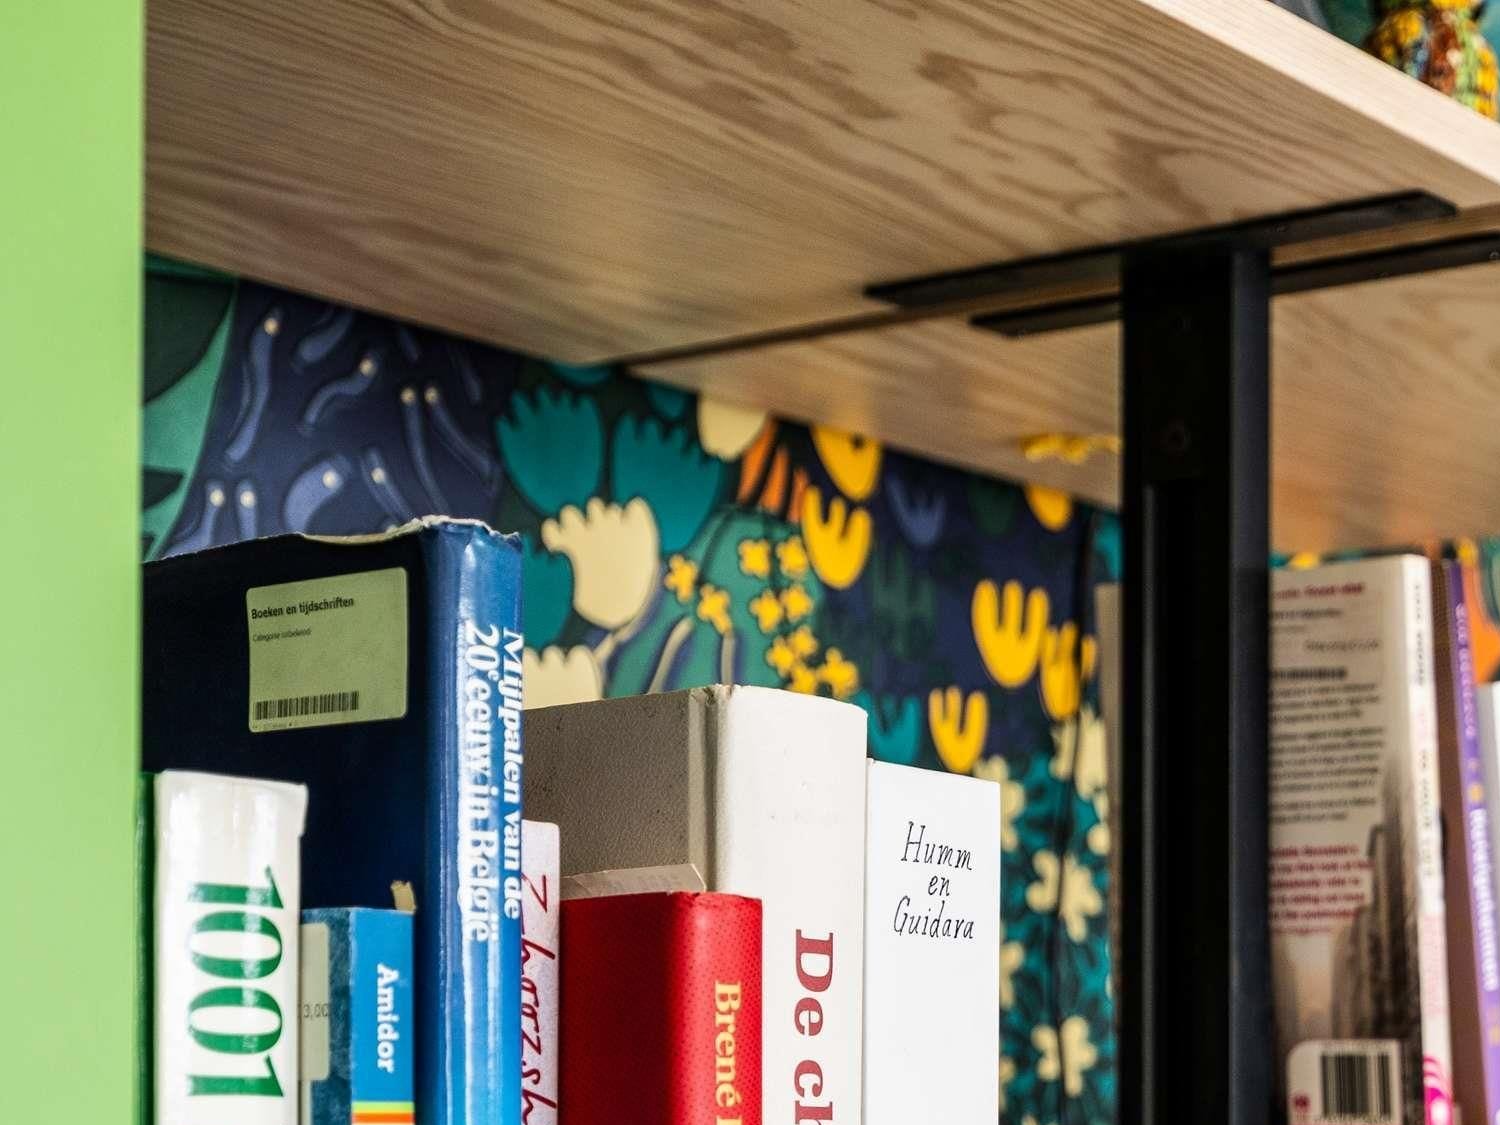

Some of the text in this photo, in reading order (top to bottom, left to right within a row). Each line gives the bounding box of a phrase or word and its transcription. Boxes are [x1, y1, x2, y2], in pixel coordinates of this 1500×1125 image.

[251, 596, 355, 620] Boeken en tijdschriften
[464, 678, 492, 777] eeuw
[498, 627, 524, 920] Mijlpalen van de
[463, 783, 499, 830] in
[900, 821, 973, 872] Humm
[458, 830, 499, 942] België
[893, 895, 975, 940] Guidara
[927, 873, 951, 896] en
[187, 865, 285, 1099] 1001
[376, 964, 399, 1073] Amidor
[793, 928, 834, 1037] De
[715, 980, 742, 1107] Brené
